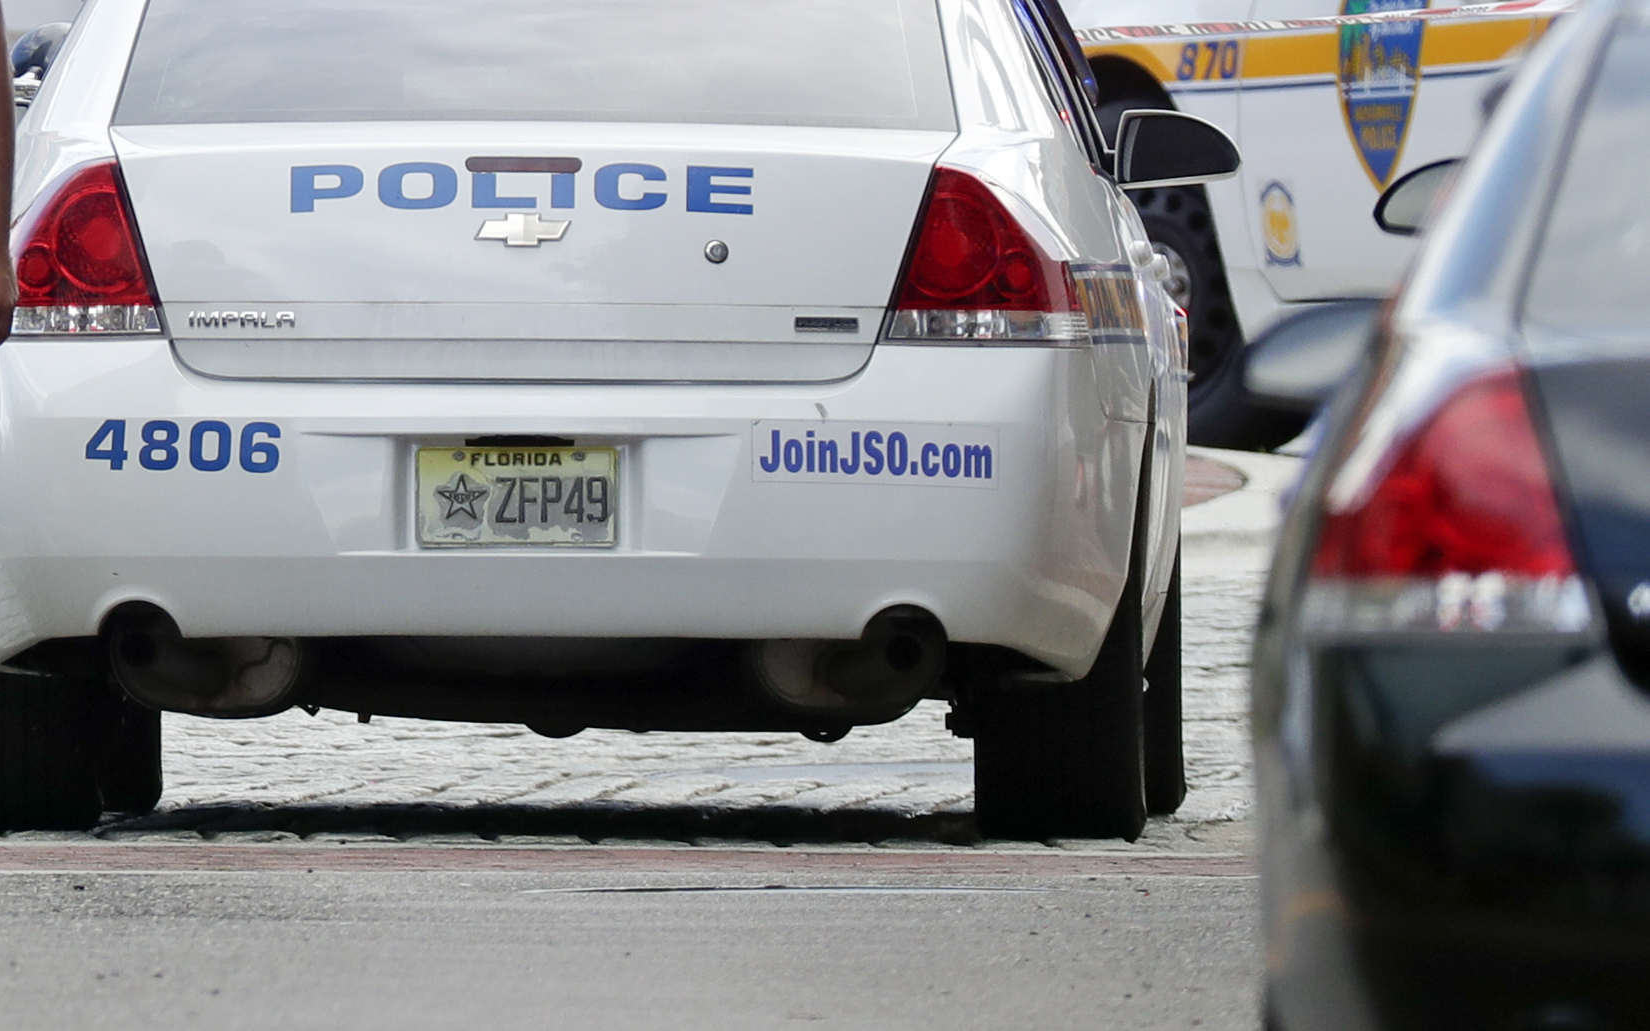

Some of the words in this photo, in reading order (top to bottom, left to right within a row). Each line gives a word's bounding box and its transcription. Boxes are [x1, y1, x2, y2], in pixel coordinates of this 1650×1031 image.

[1177, 40, 1239, 81] 870
[290, 161, 754, 214] POLICE
[188, 310, 296, 328] IMPALA
[85, 419, 282, 473] 4806
[470, 453, 562, 467] FLORIDA
[760, 429, 993, 480] JoinJSO.com
[495, 476, 608, 523] ZFP49
